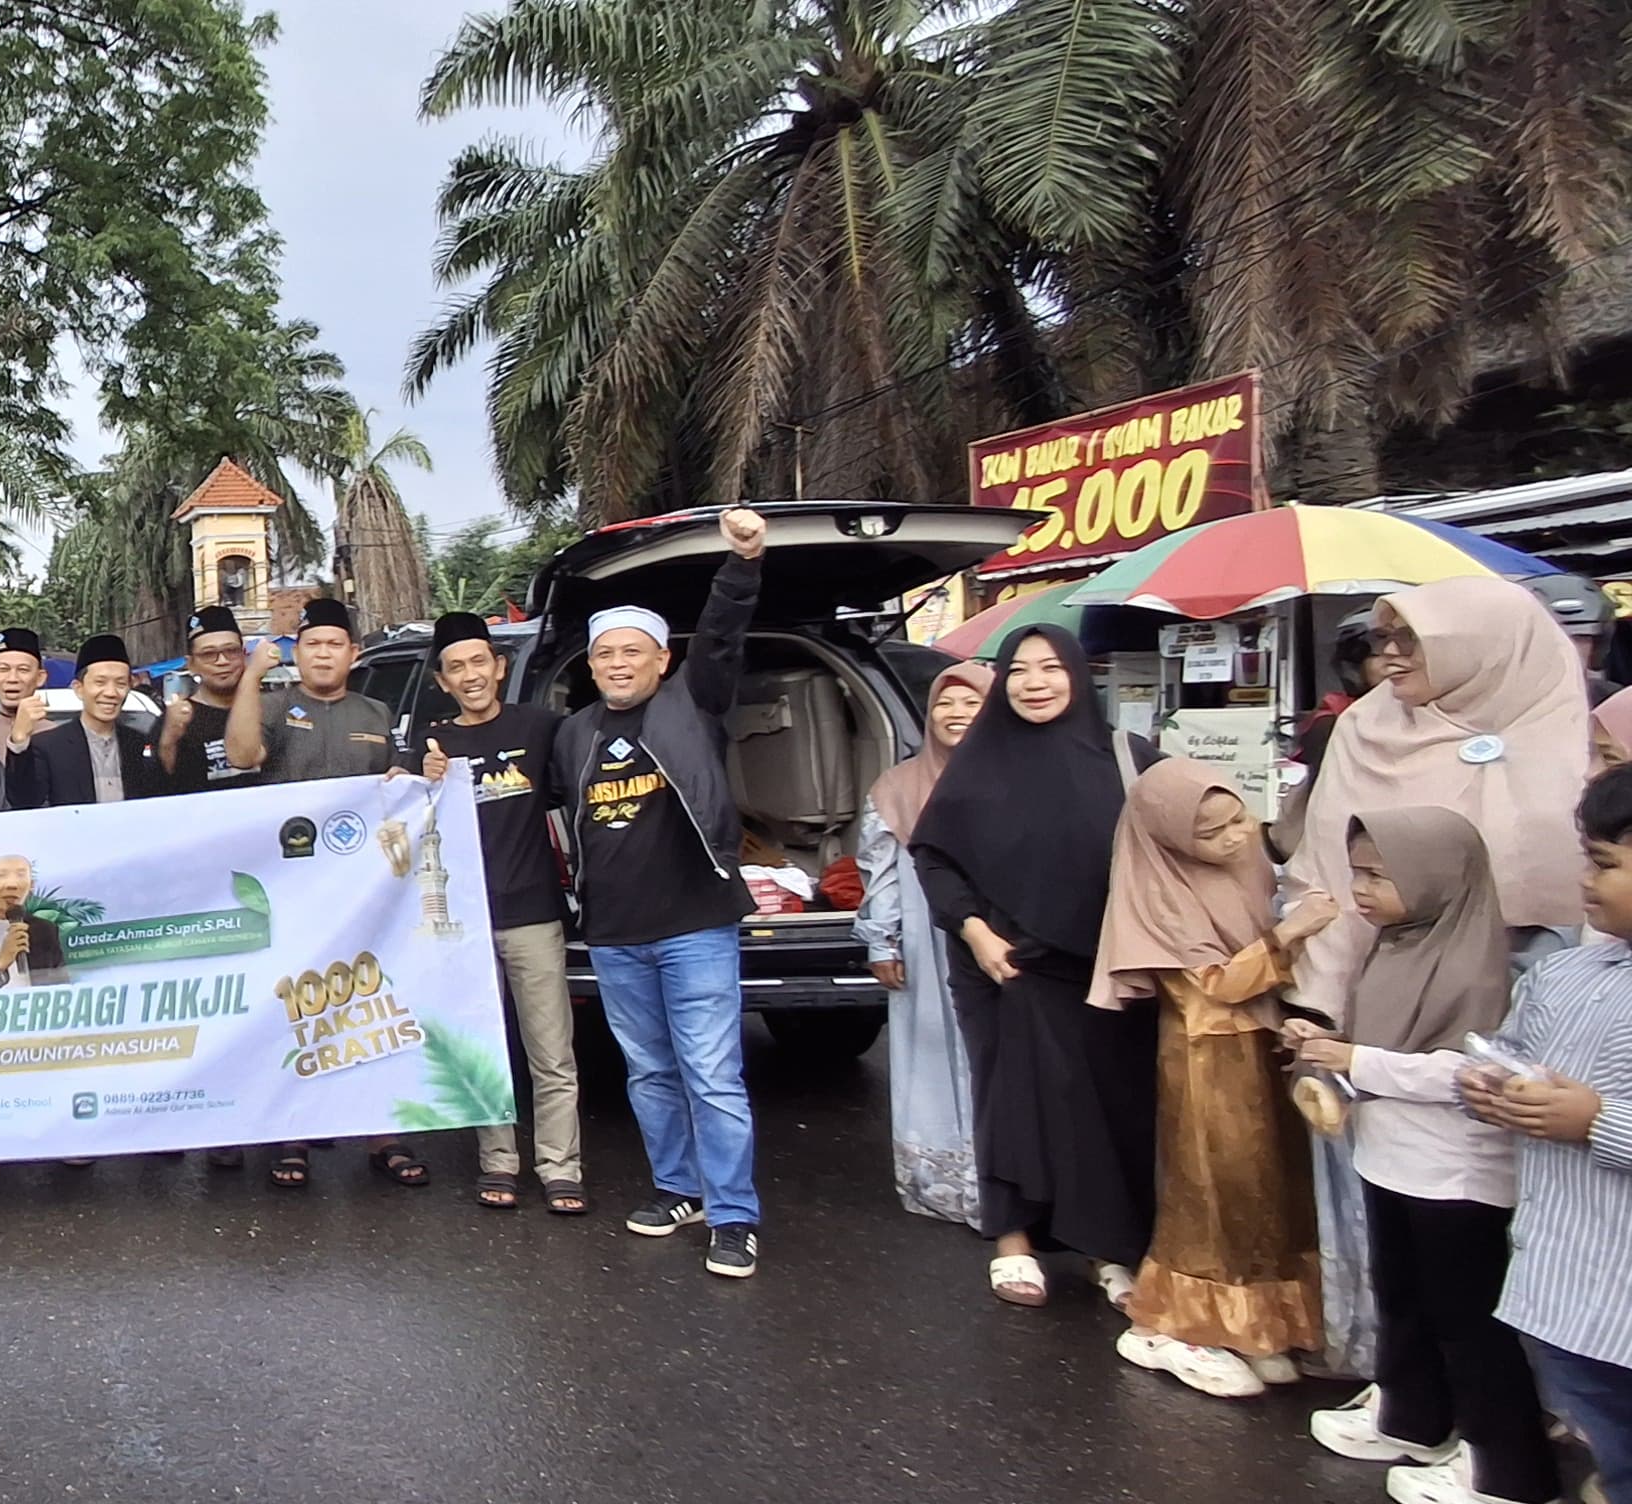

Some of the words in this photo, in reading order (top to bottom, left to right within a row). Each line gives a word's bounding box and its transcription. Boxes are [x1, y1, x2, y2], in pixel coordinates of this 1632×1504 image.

[1025, 435, 1081, 478] BAKAR
[1103, 413, 1163, 460] AYAM
[1169, 394, 1246, 446] BAKAR
[140, 973, 249, 1024] TAKJIL
[274, 951, 383, 1022] 1000
[100, 1037, 180, 1056] NASUHA
[292, 994, 409, 1047] TAKJIL
[295, 1020, 421, 1077] GRATIS
[13, 1096, 51, 1108] School
